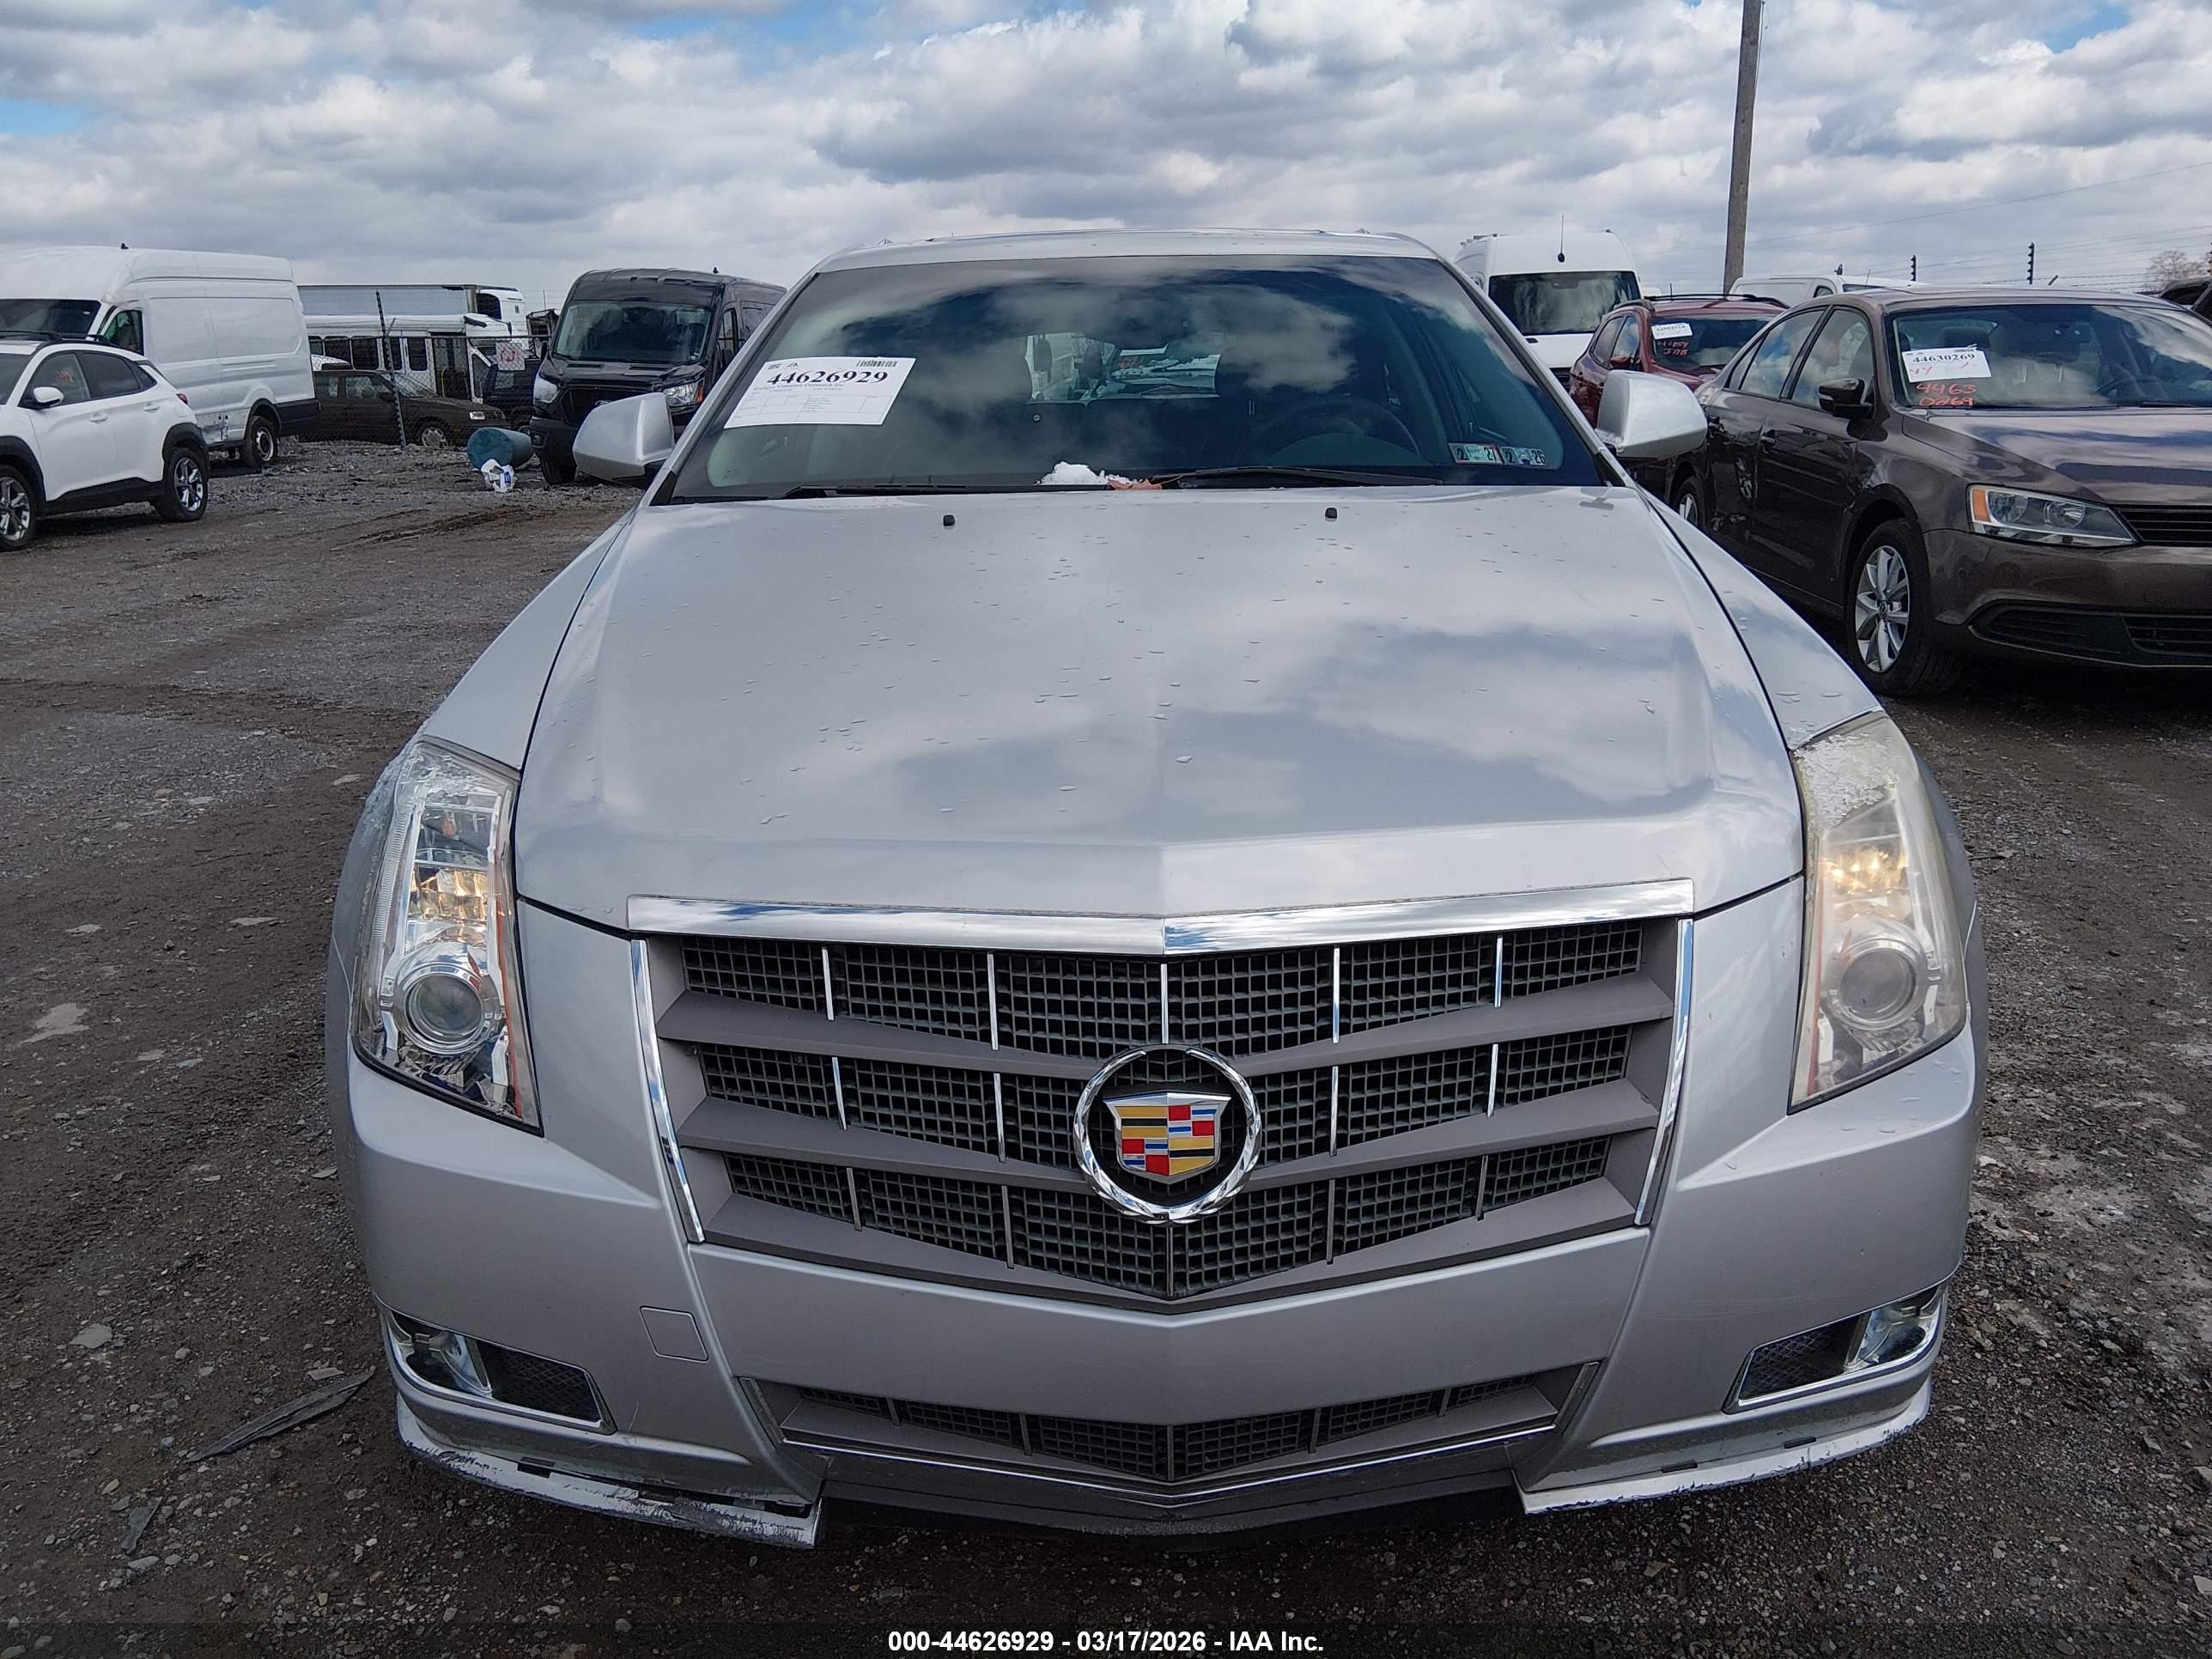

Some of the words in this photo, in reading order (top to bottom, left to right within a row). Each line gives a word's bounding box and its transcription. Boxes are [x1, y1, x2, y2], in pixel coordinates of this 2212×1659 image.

[1913, 353, 1975, 362] 44630269
[767, 370, 888, 385] 44626929
[1530, 449, 1547, 465] 26
